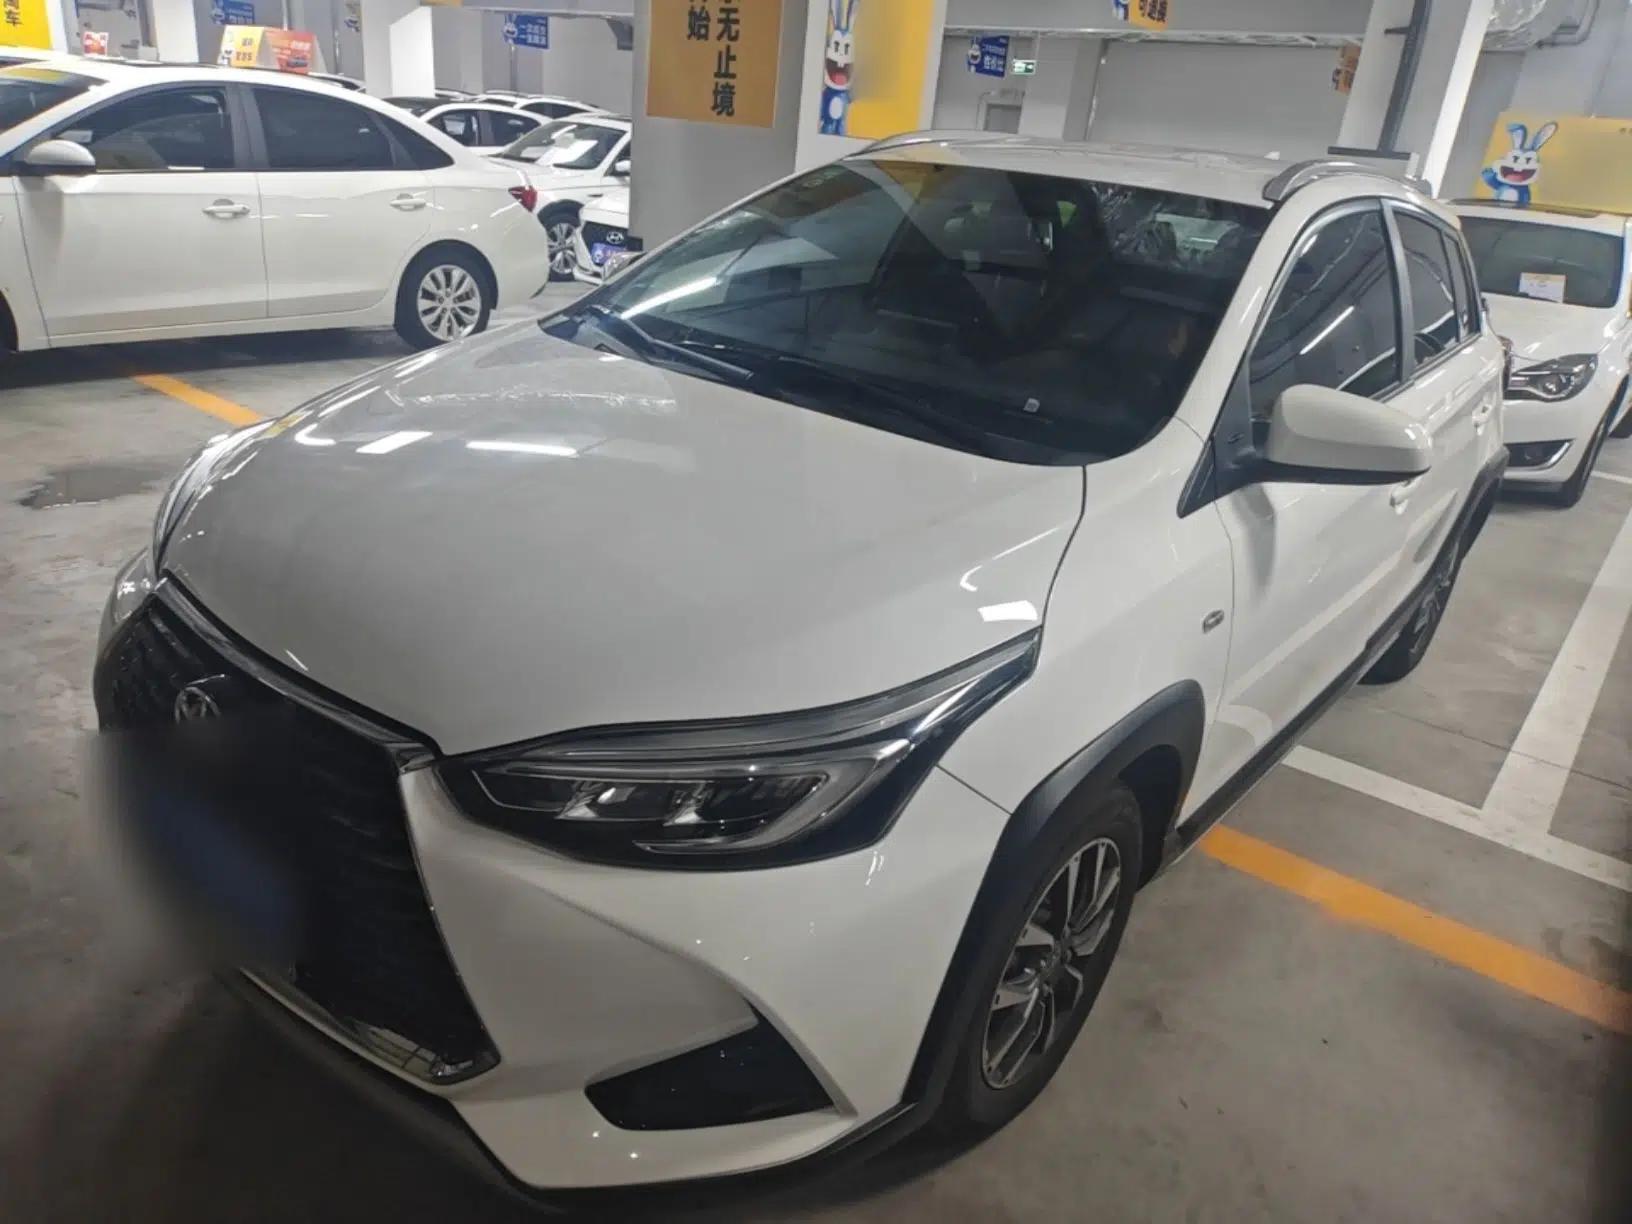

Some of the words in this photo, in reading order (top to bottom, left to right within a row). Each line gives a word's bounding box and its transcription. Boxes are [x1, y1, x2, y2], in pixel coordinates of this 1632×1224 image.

[687, 0, 711, 41] 始
[710, 0, 740, 117] 无止境
